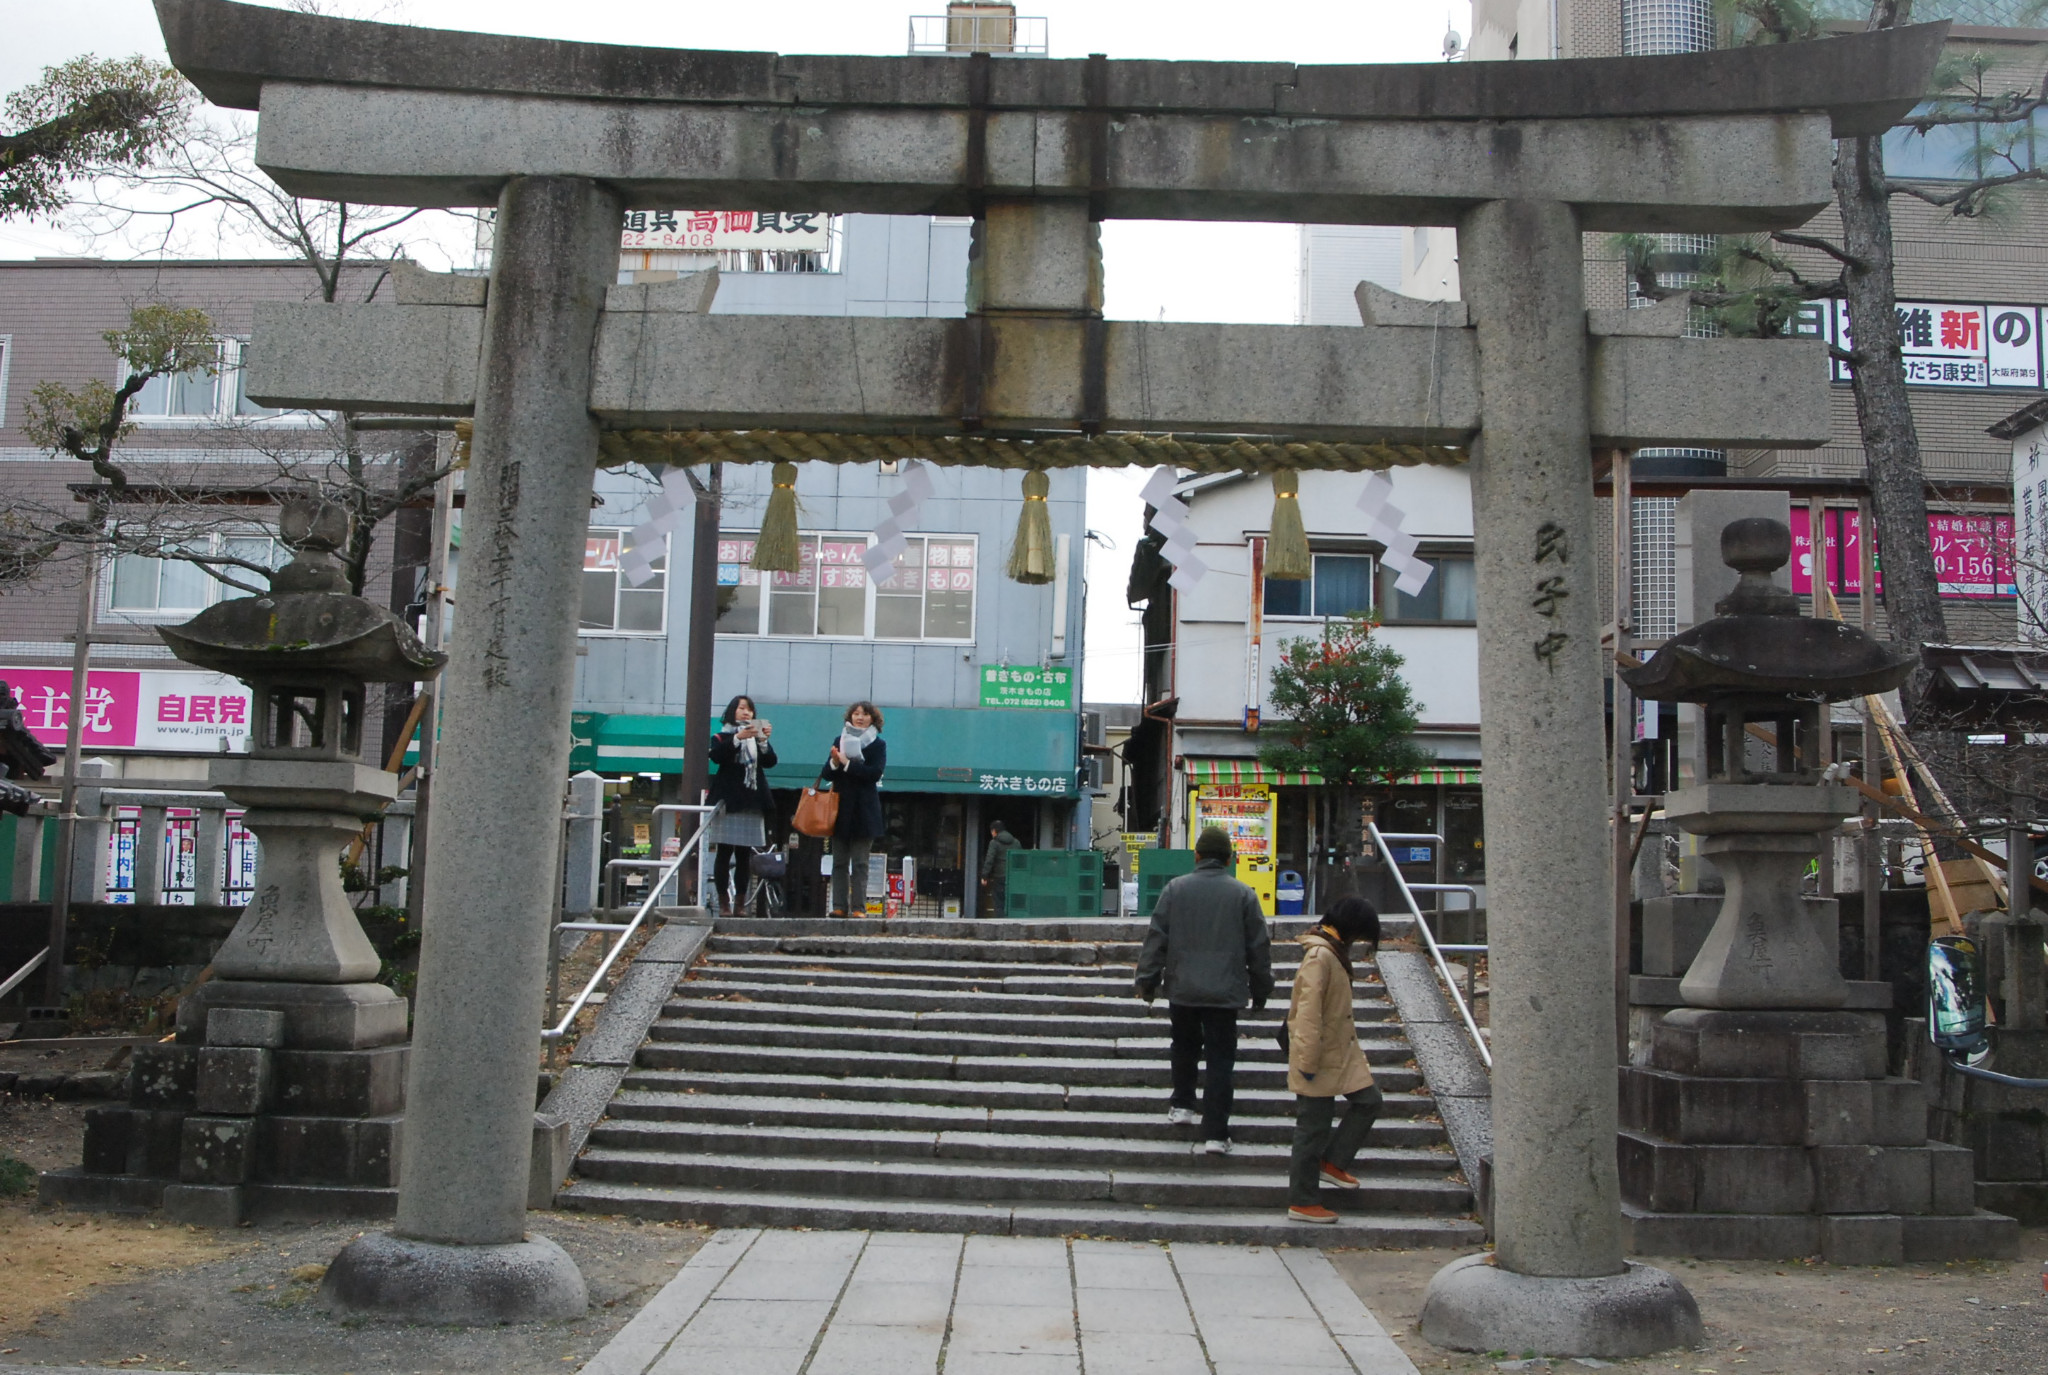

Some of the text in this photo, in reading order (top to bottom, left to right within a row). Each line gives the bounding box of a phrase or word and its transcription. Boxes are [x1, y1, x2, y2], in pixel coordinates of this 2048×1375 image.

[1790, 304, 2031, 349] 日維新の
[1901, 361, 1976, 383] だち康史
[1930, 519, 2008, 534] 結婚相談所
[1795, 535, 1836, 547] 株社
[158, 694, 246, 723] 自民党
[158, 726, 244, 736] www.jimin.jp
[980, 775, 1067, 793] 茨木きもの店
